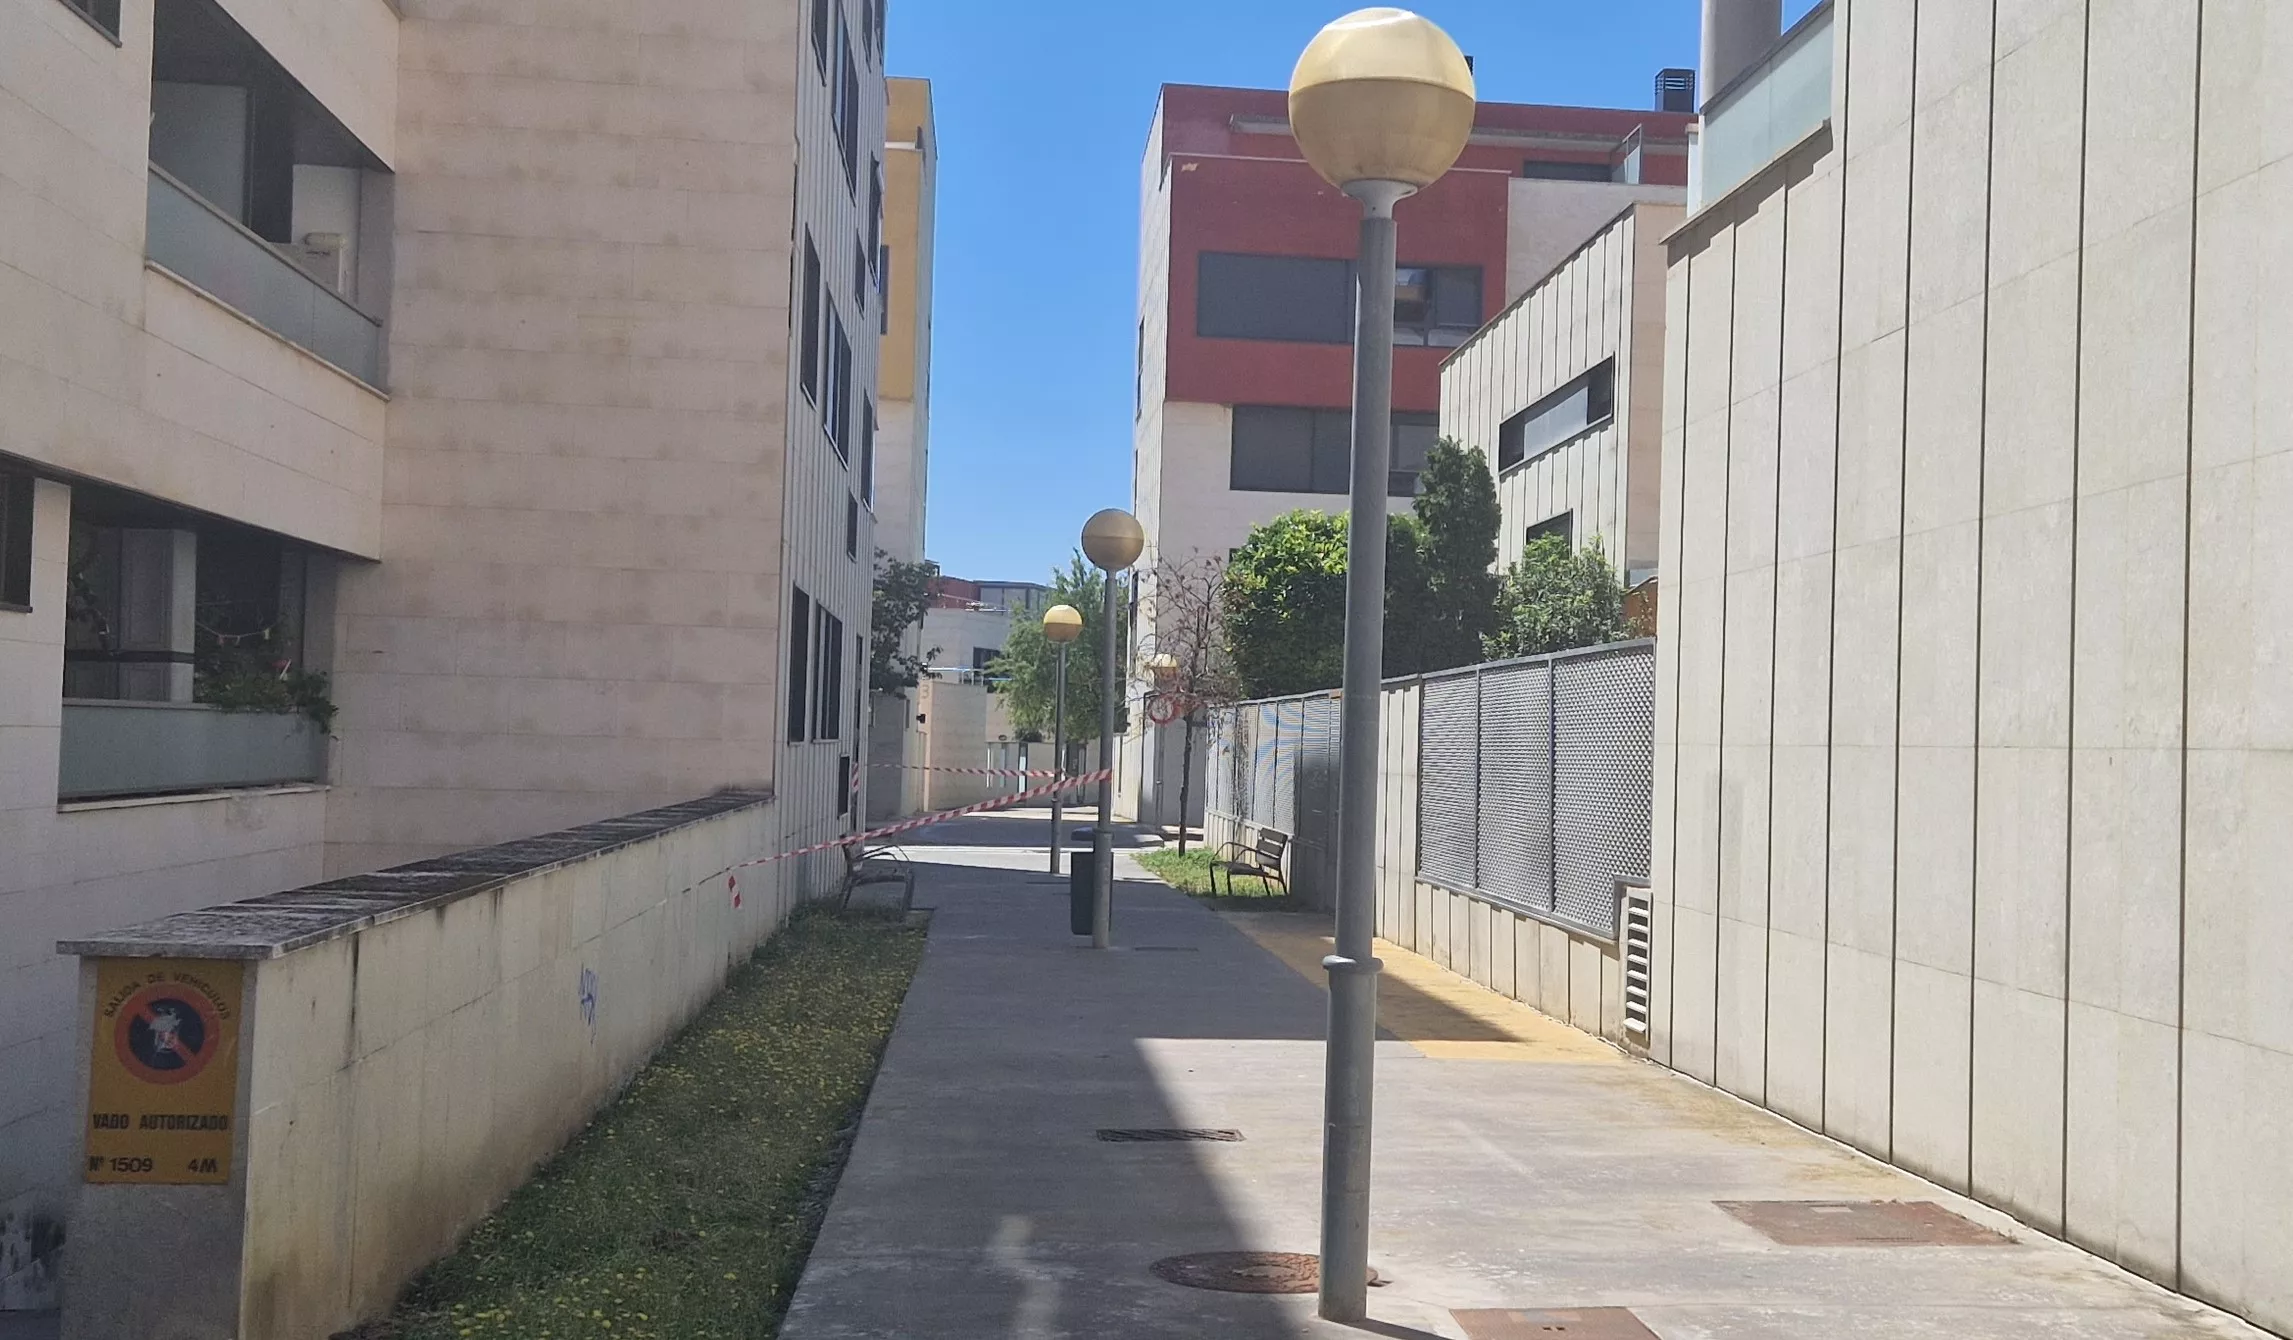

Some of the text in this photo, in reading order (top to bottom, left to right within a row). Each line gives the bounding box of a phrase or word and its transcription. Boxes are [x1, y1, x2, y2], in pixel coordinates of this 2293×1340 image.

[148, 974, 164, 984] DE
[93, 1114, 229, 1131] VADO AUTORIZADO
[109, 1157, 153, 1172] 1509
